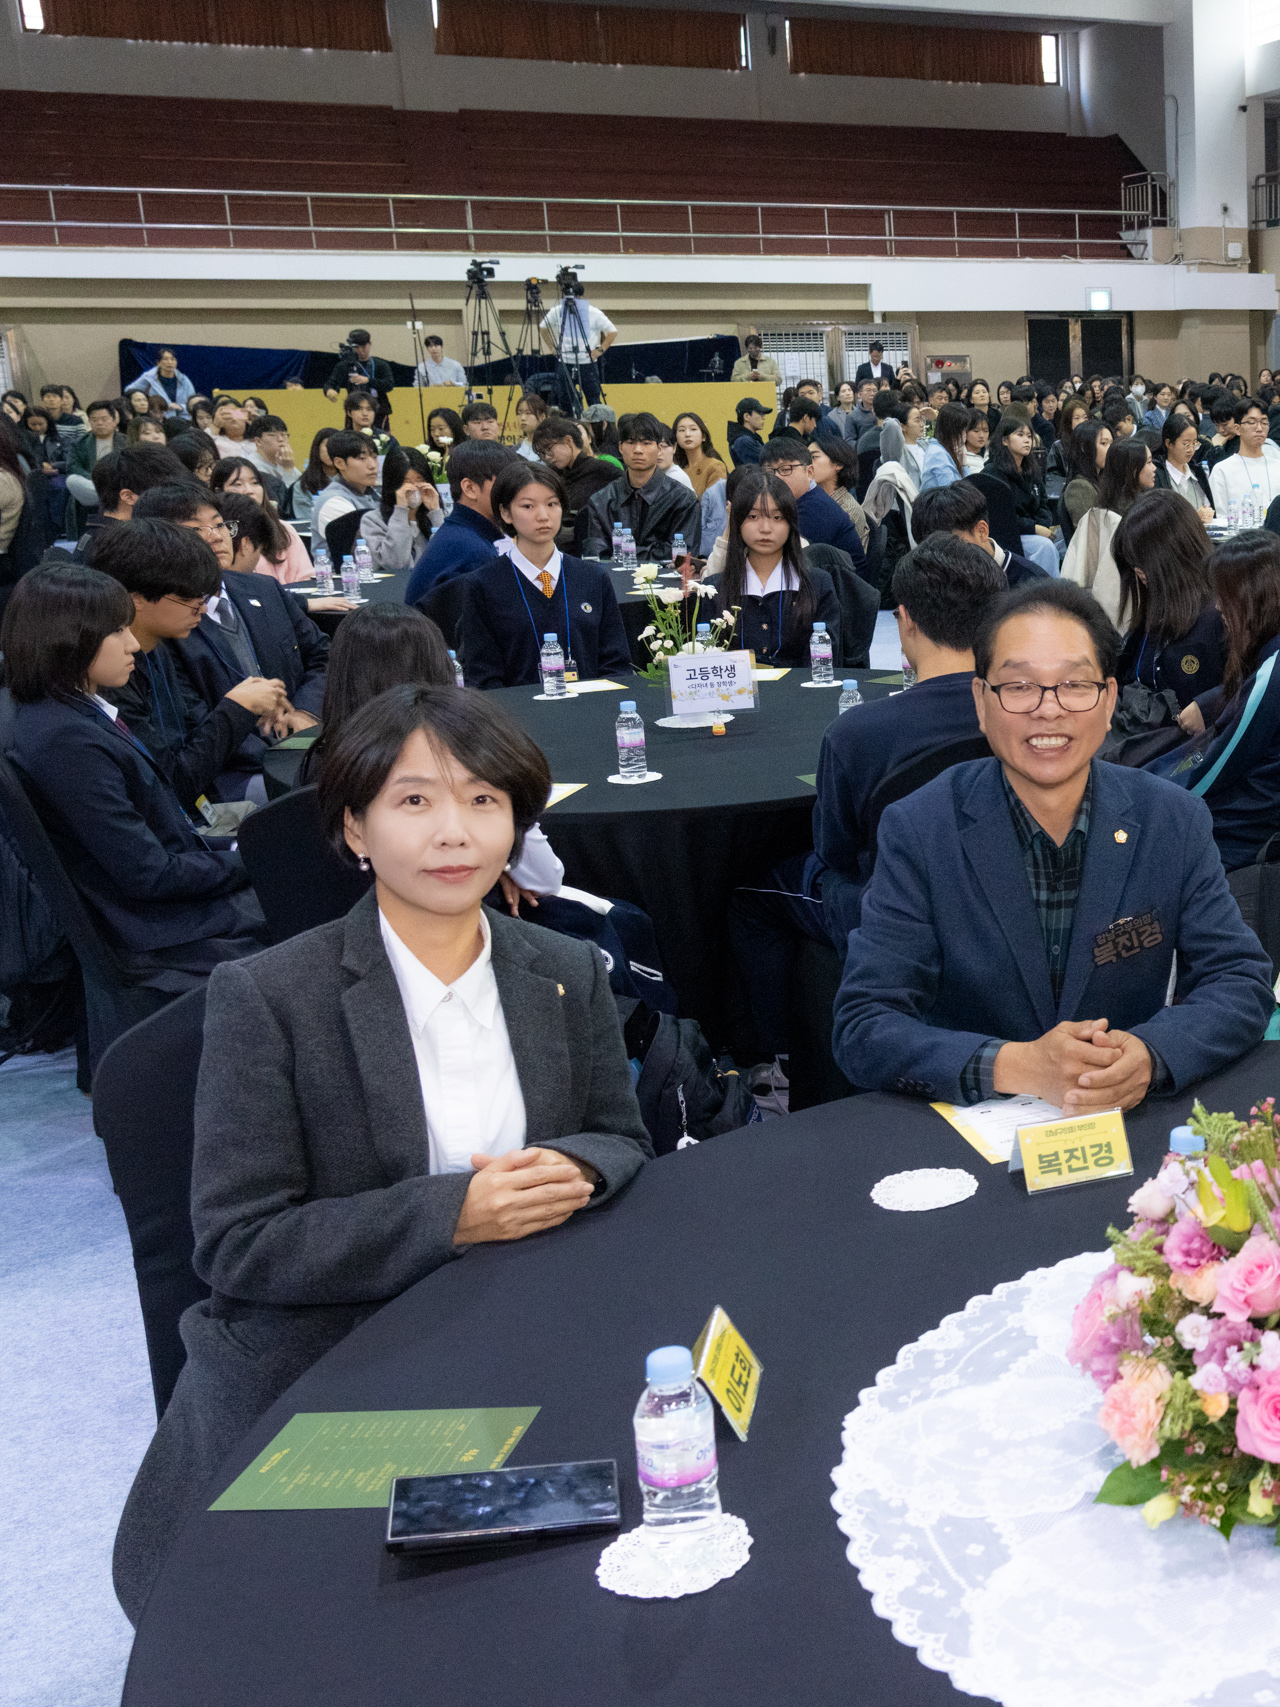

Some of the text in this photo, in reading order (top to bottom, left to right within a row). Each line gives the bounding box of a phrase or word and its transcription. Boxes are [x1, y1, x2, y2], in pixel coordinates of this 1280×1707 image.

[685, 664, 736, 681] 고등학생
[1094, 921, 1162, 965] 복진경
[1045, 1125, 1077, 1137] 강남구의회
[1038, 1141, 1114, 1176] 복진경
[725, 1345, 753, 1413] 이도희
